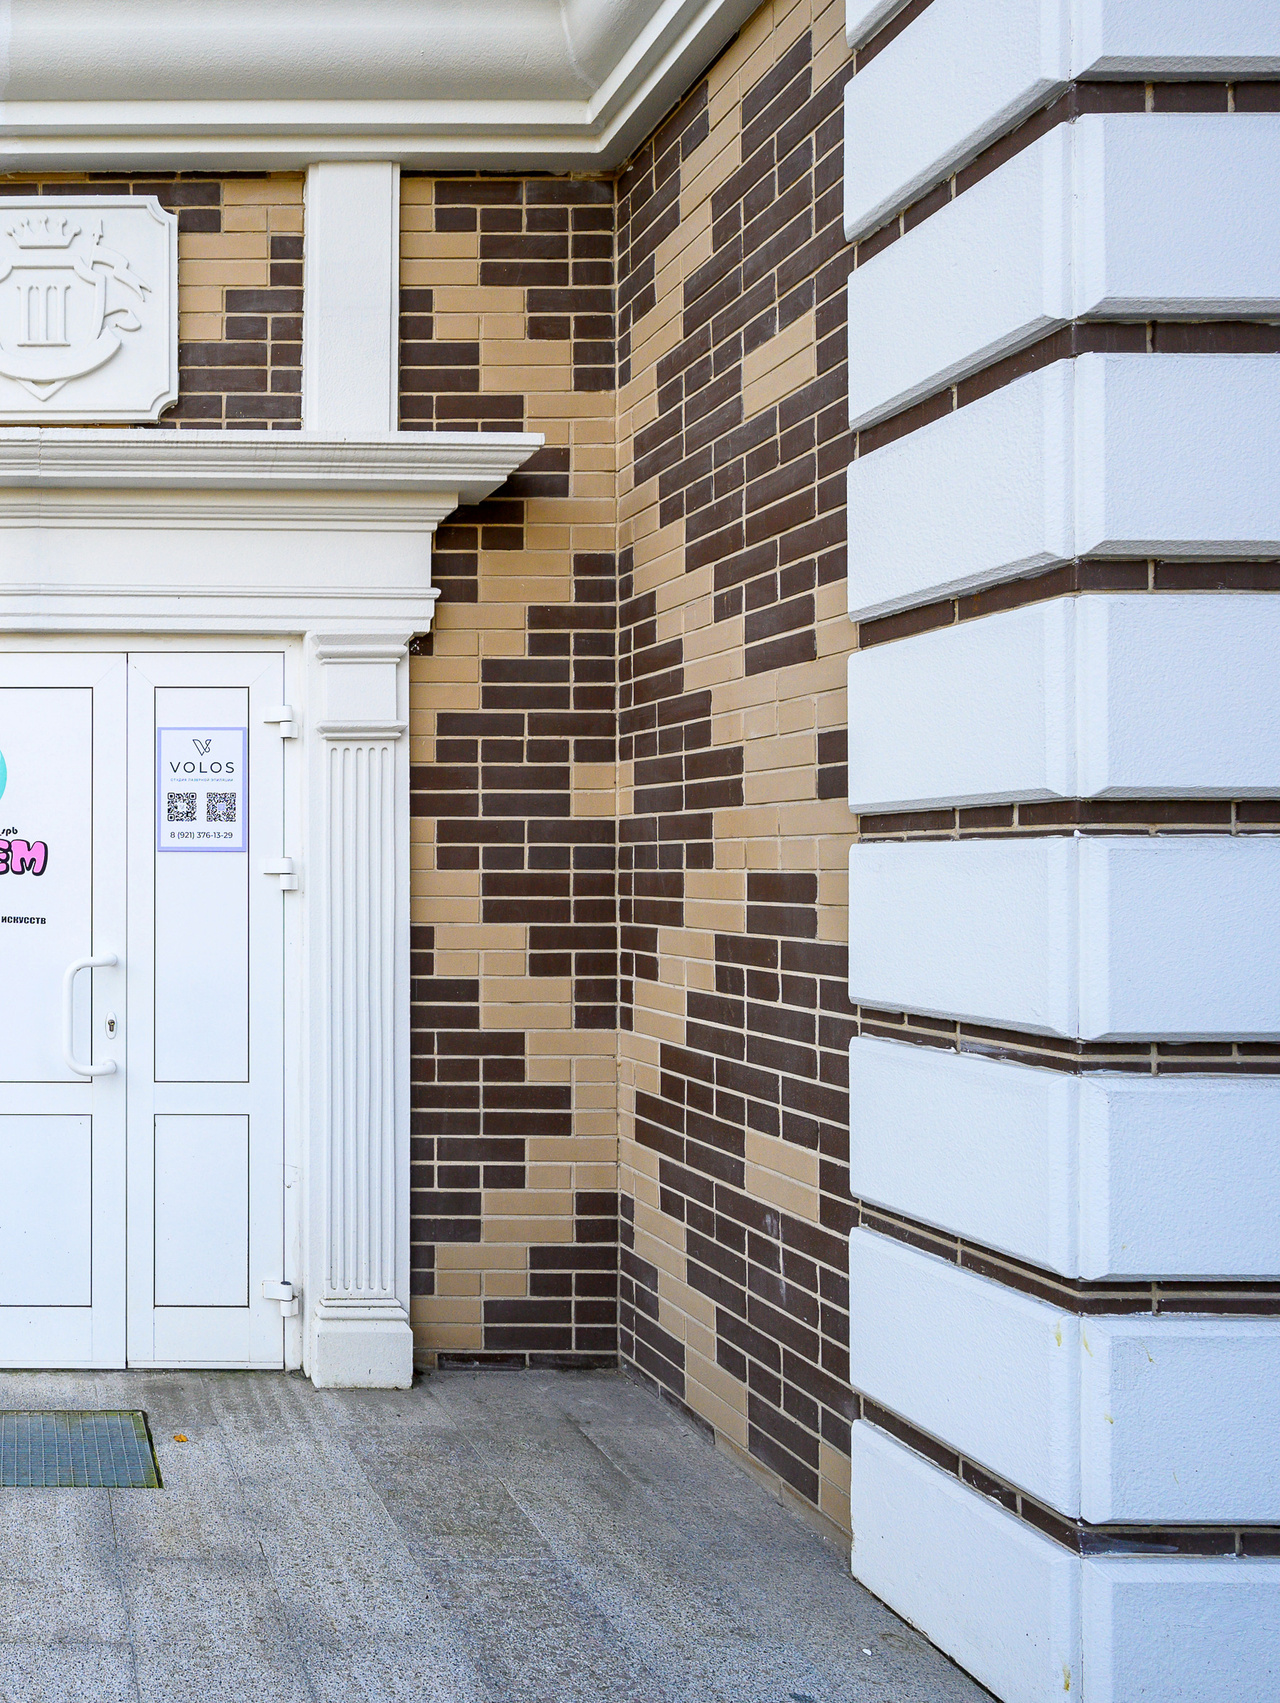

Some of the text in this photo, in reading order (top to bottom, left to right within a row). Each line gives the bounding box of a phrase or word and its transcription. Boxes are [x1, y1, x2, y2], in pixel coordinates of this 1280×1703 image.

[169, 761, 235, 774] VOLOS
[170, 831, 234, 840] 8 (921) 376-13-29
[1, 916, 47, 926] ИСКУССТВ
